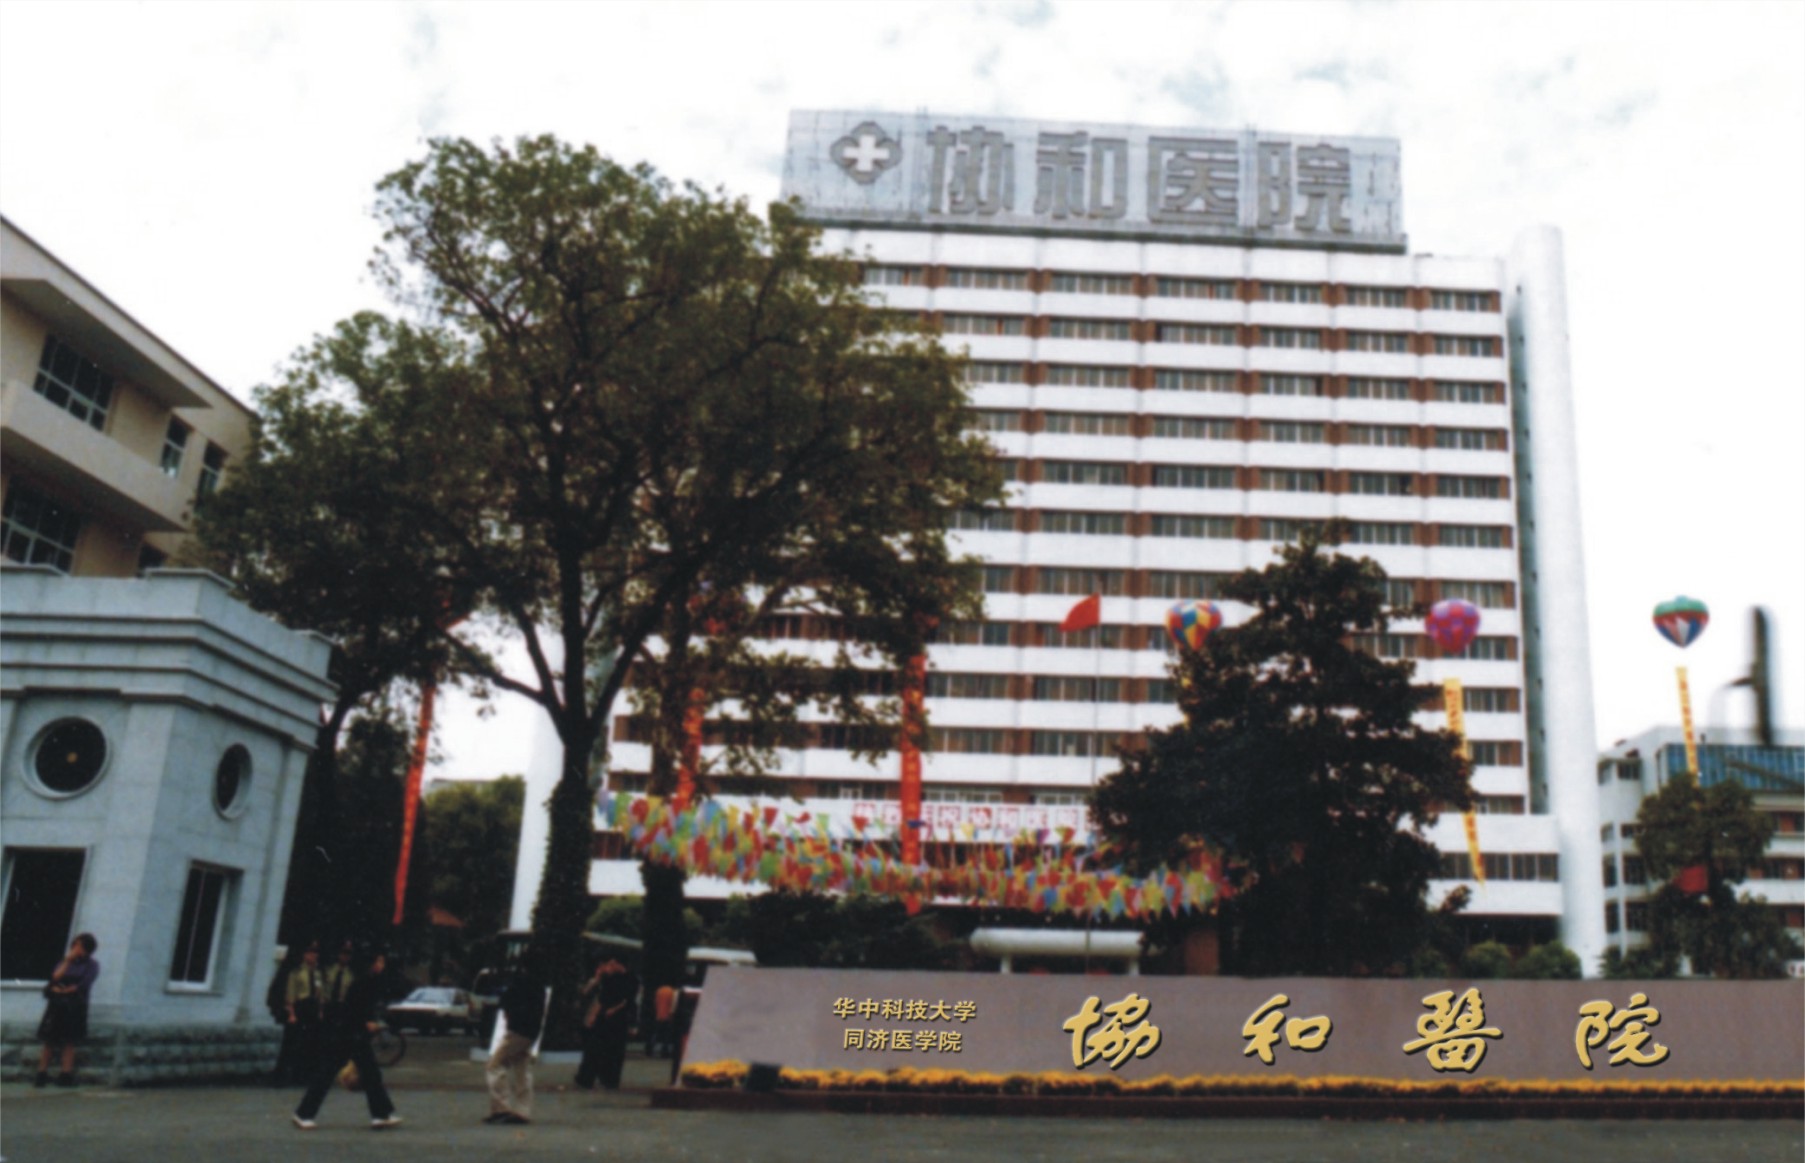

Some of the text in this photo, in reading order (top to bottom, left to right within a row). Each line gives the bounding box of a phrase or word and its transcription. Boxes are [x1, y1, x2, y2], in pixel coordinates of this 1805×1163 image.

[926, 127, 1352, 231] 协和医院
[833, 997, 977, 1022] 华中科技大学
[843, 1028, 962, 1052] 同济医学院
